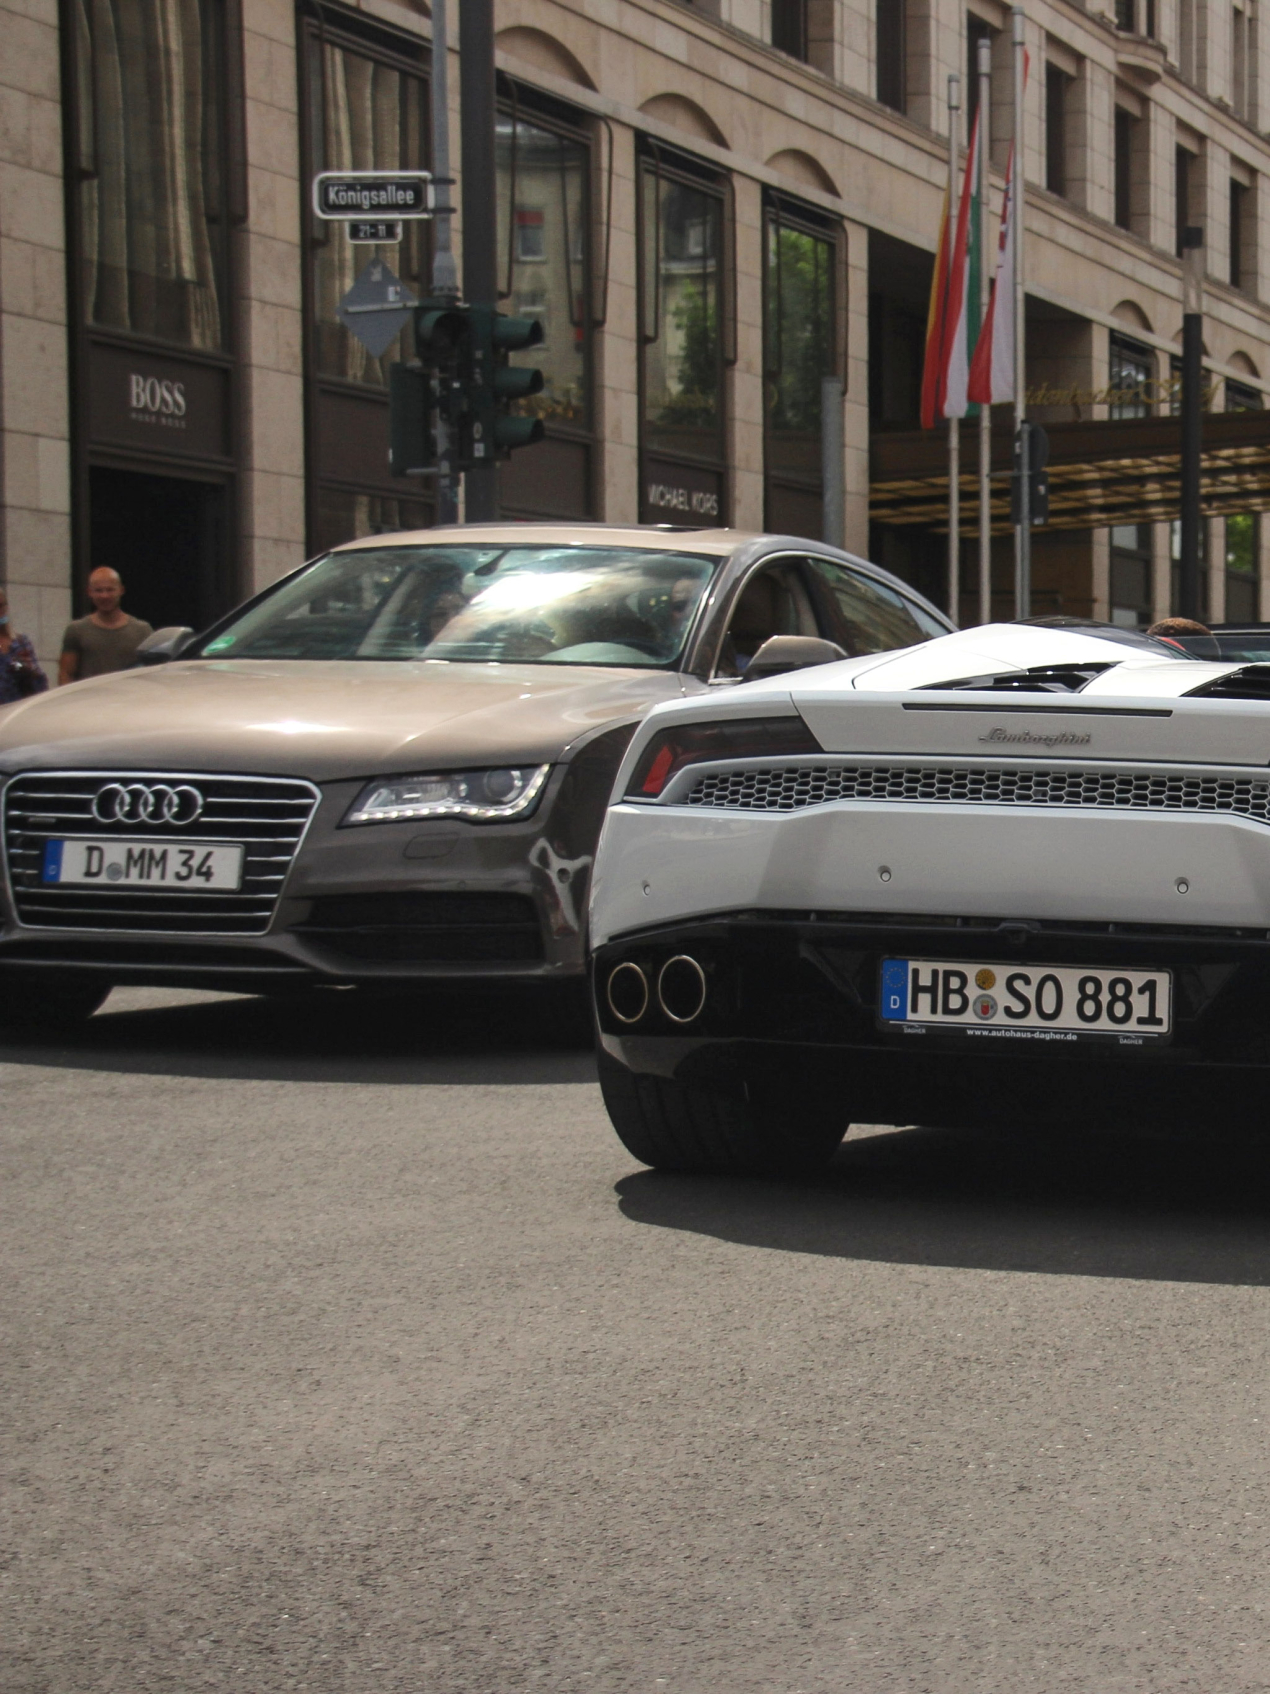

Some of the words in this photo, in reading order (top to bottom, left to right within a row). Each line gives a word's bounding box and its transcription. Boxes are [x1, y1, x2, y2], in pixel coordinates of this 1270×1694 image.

[328, 184, 415, 209] Königsallee
[130, 373, 186, 416] BOSS
[978, 726, 1092, 748] Lamborghini
[83, 845, 104, 878] D
[125, 848, 168, 880] MM
[174, 848, 214, 882] 34
[890, 996, 900, 1009] D
[910, 967, 970, 1016] HB
[1003, 972, 1064, 1022] SO
[1075, 975, 1166, 1026] 881
[966, 1028, 1078, 1042] www.autohaus-dagher.de
